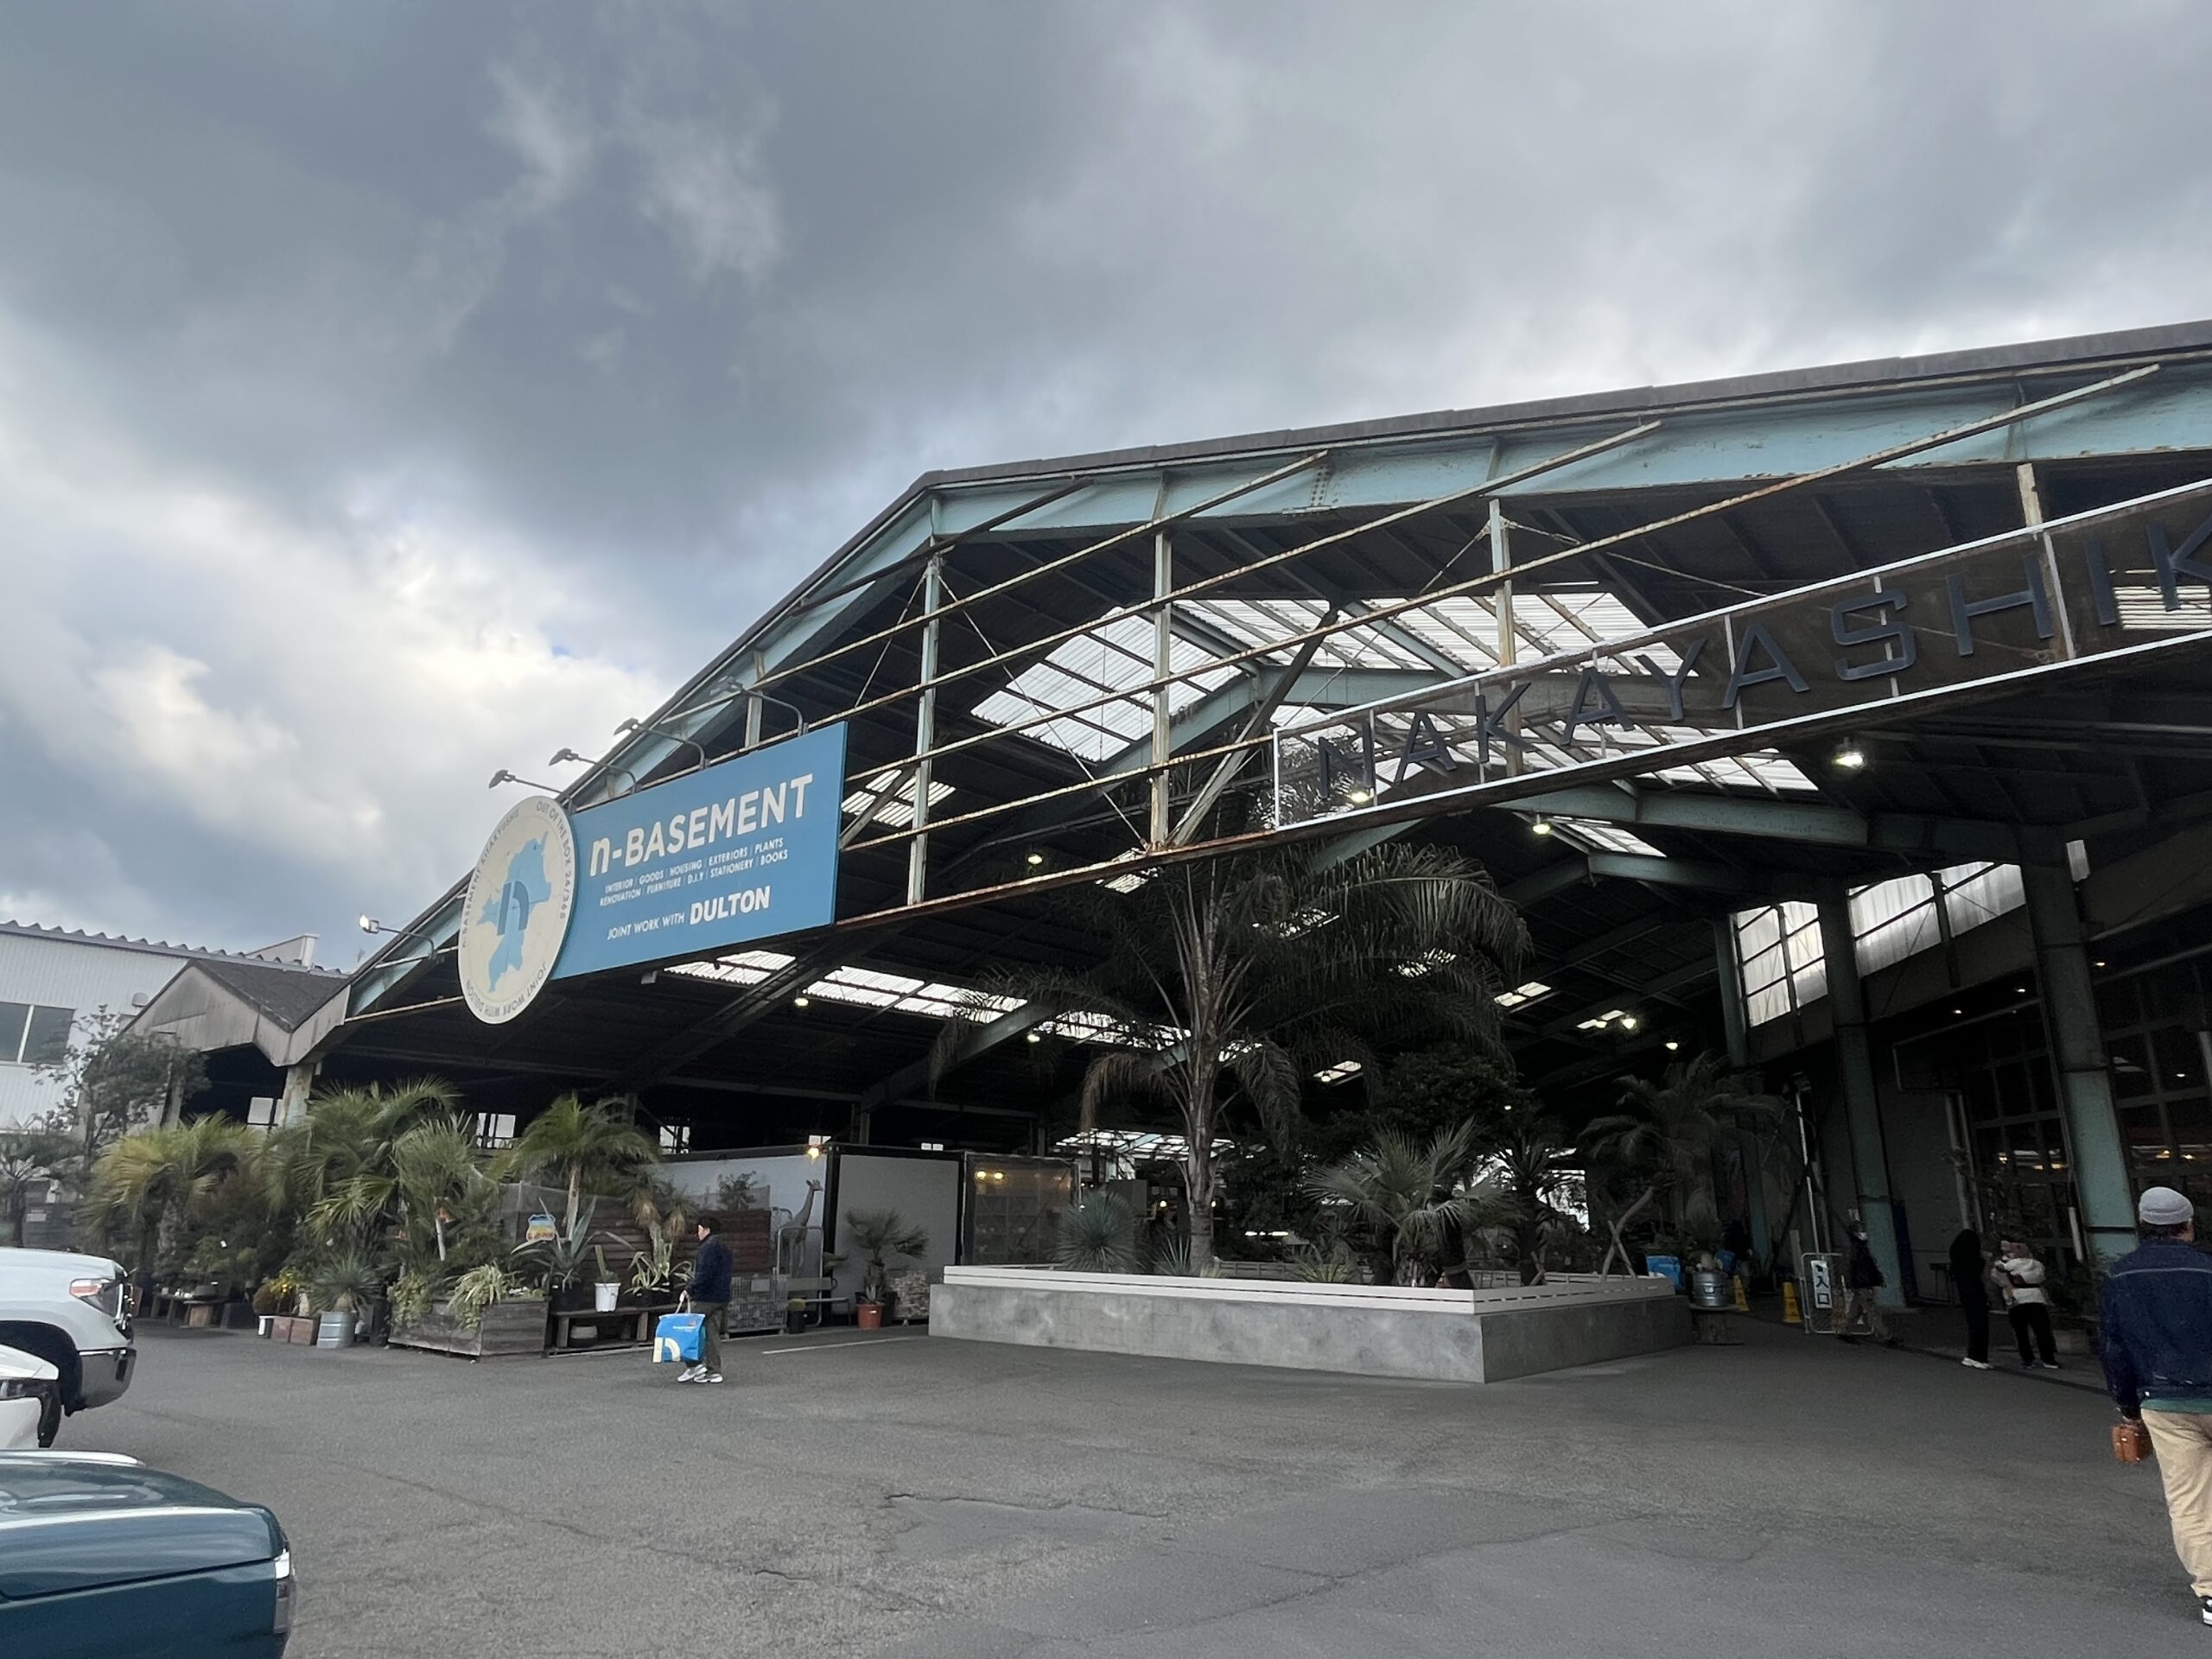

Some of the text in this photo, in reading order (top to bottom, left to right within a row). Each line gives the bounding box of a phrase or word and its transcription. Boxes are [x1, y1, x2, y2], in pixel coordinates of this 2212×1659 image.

[589, 773, 813, 877] n-BASEMENT
[600, 888, 641, 906] RENOVATION
[646, 877, 682, 894] FURNITURE
[710, 859, 753, 879] STATIONERY
[760, 849, 788, 866] BOOKS
[605, 837, 784, 893] INTERIOR GOODS HOUSING EXTERIORS PLANTS
[607, 885, 772, 940] JOINT WORK WITH DULTON
[1815, 1274, 1829, 1305] 入口
